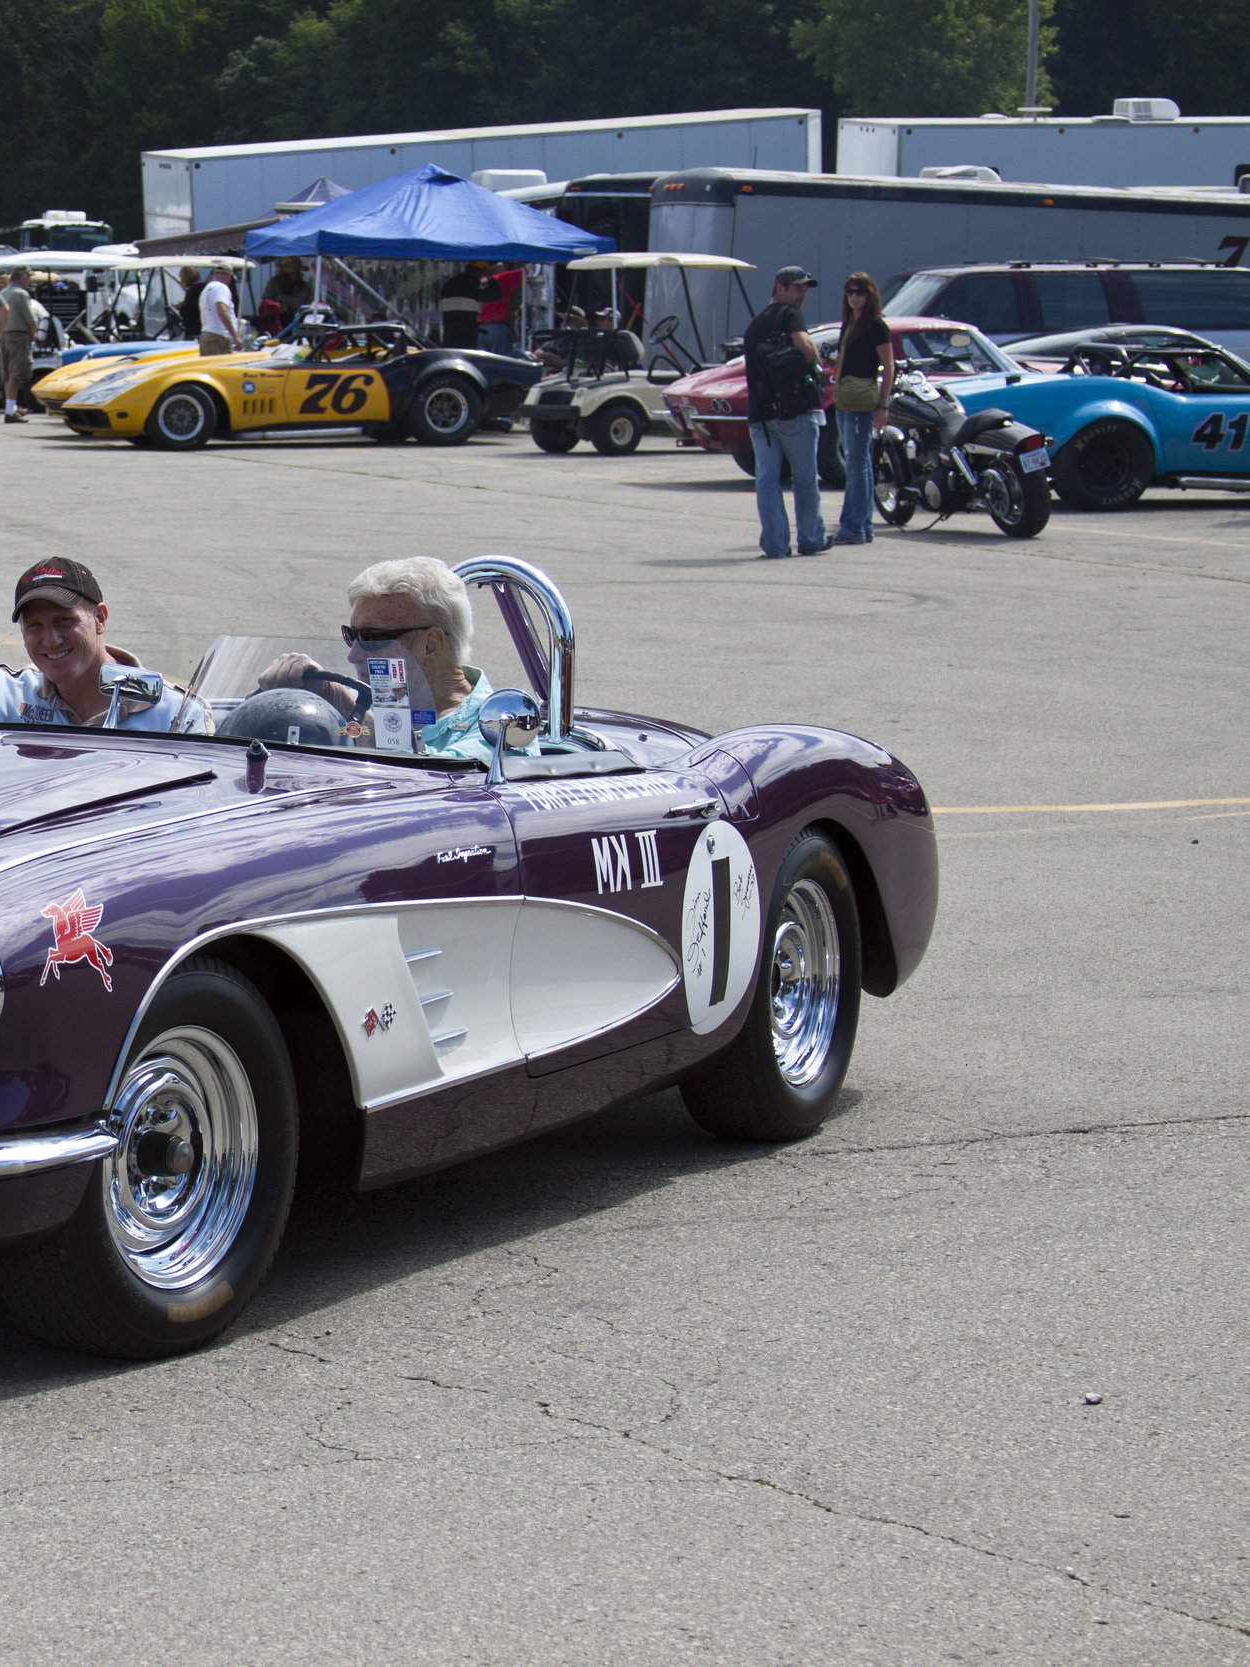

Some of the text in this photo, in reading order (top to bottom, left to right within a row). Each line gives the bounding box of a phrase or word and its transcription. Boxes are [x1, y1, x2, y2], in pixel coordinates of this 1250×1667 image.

[299, 374, 374, 415] 76
[1190, 411, 1250, 452] 41
[634, 829, 664, 889] III
[709, 855, 731, 1008] 1
